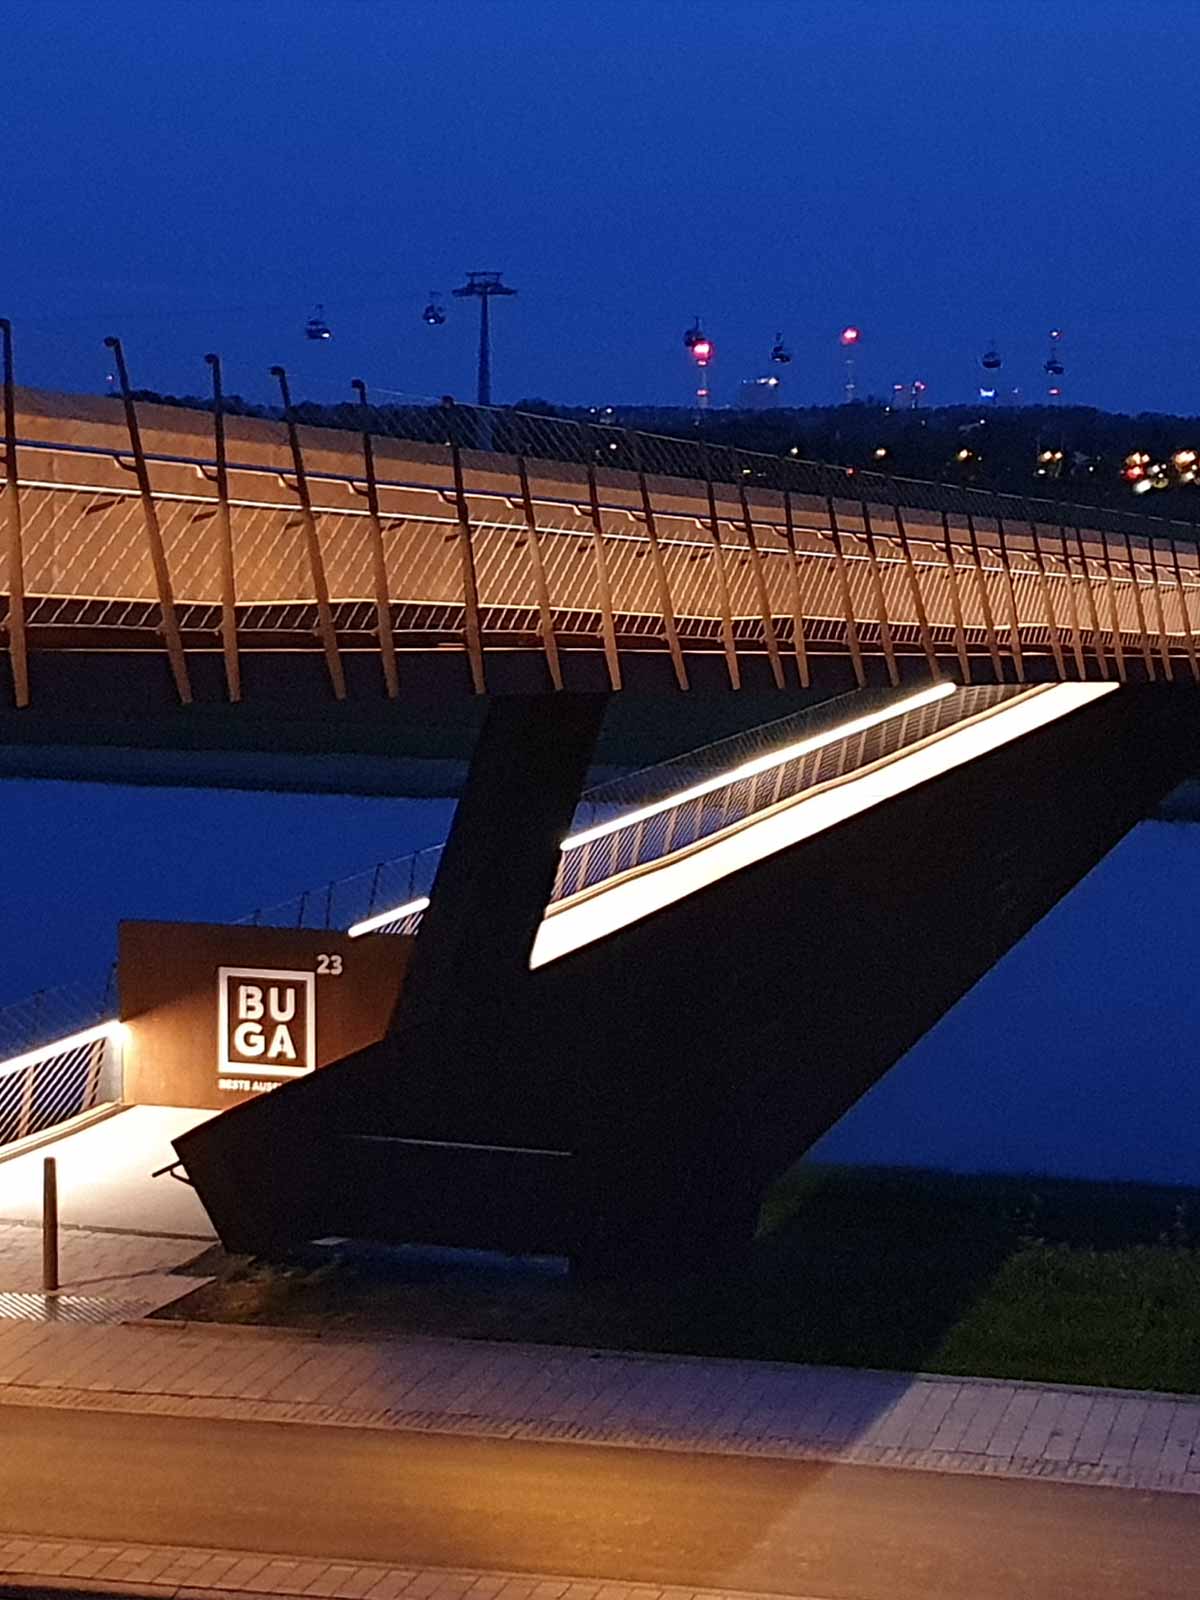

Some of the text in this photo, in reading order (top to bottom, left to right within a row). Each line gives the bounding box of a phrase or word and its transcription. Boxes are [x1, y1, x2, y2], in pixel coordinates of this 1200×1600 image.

[316, 954, 343, 975] 23
[238, 984, 296, 1022] BU
[233, 1021, 297, 1059] GA
